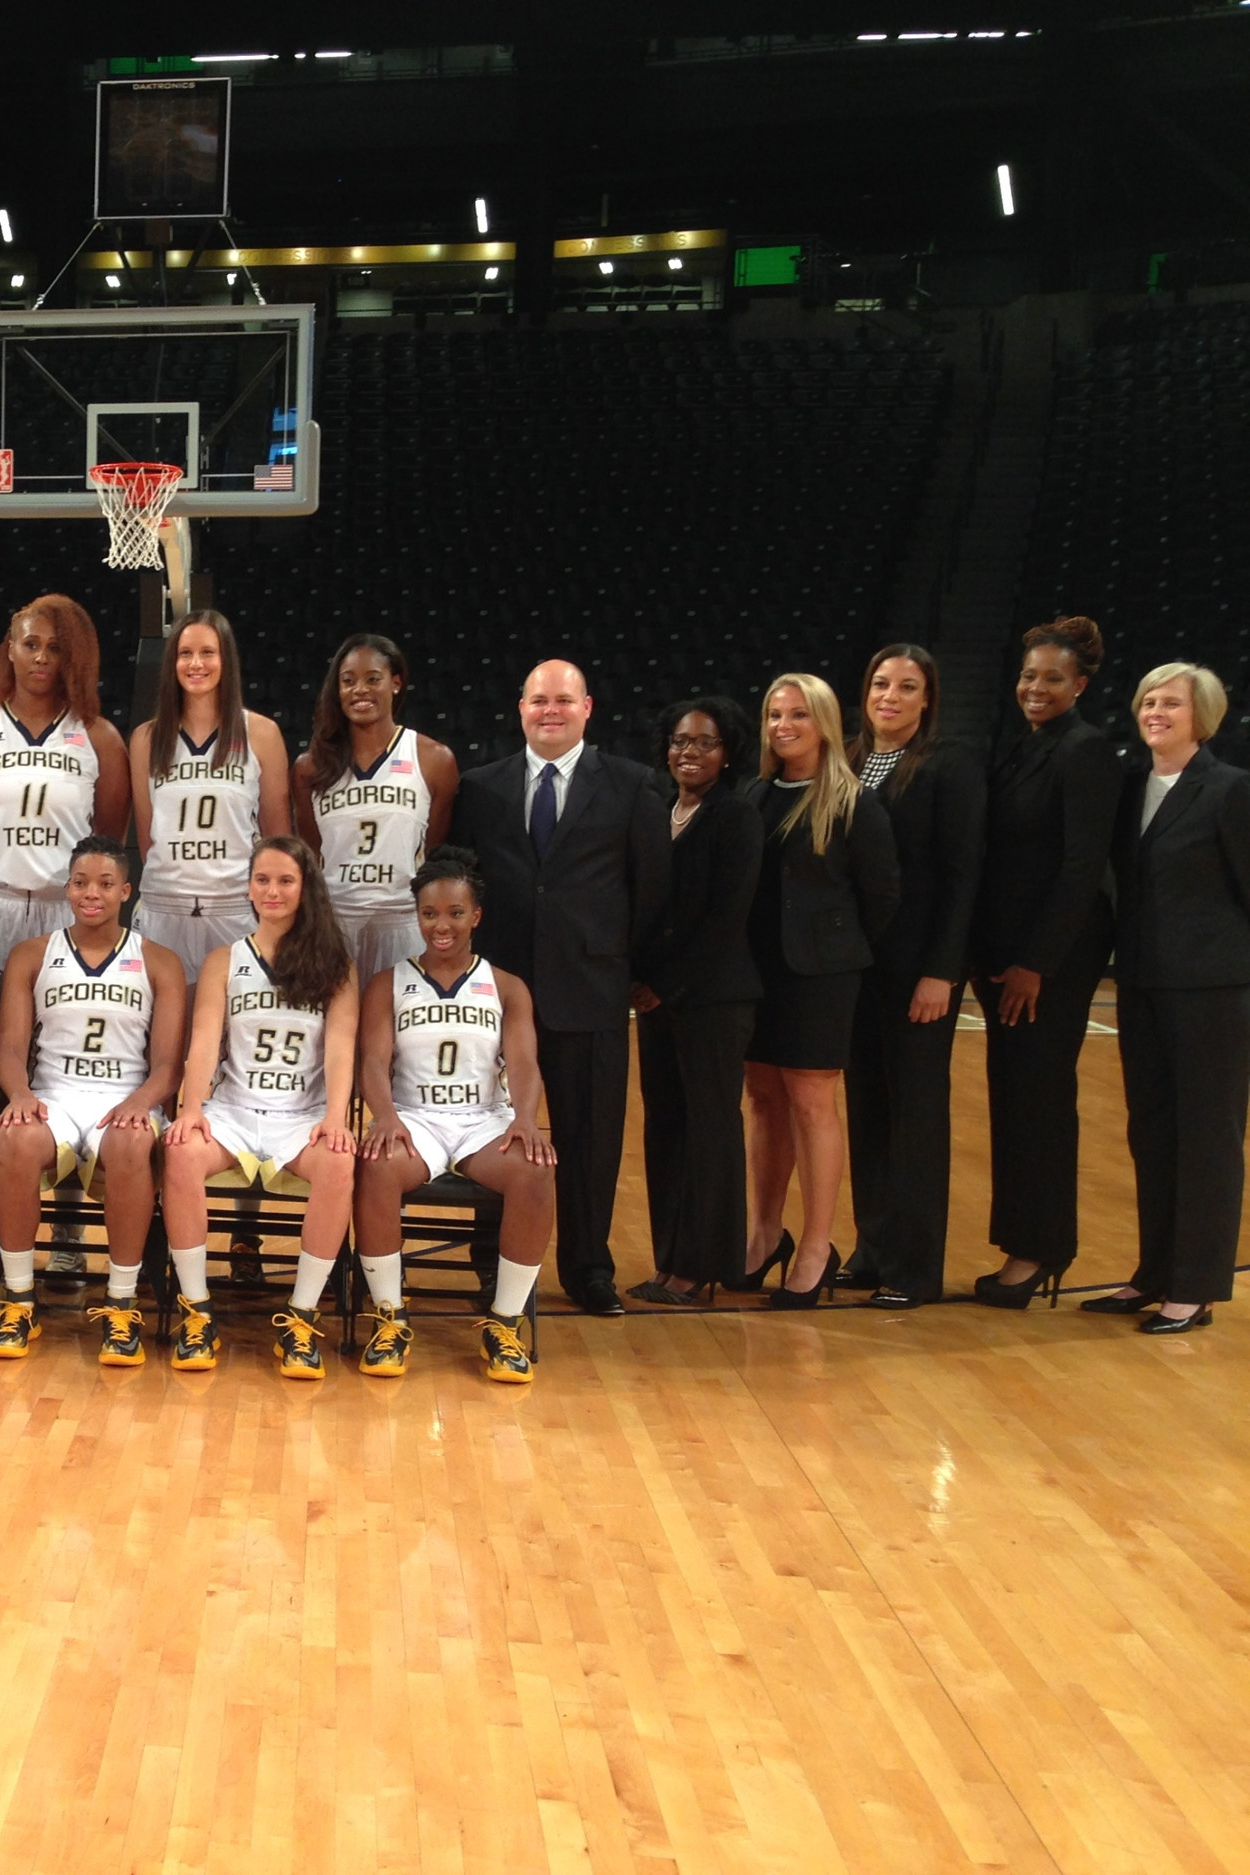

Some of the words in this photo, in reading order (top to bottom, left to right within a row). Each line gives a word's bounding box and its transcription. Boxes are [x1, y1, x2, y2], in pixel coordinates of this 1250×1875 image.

[132, 82, 196, 91] DAKTRONICS
[565, 233, 688, 254] COESSS
[154, 761, 245, 788] GEORGIA
[20, 783, 48, 818] 11
[178, 795, 216, 832] 10
[319, 785, 417, 816] GEORGIA
[3, 827, 60, 847] TECH
[168, 840, 227, 860] TECH
[358, 821, 377, 855] 3
[339, 864, 393, 883] TECH
[45, 983, 143, 1012] GEORGIA
[398, 1005, 497, 1032] GEORGIA
[83, 1018, 106, 1053] 2
[254, 1028, 306, 1066] 55
[63, 1056, 122, 1079] TECH
[438, 1041, 458, 1076] 0
[246, 1070, 306, 1092] TECH
[416, 1084, 480, 1105] TECH
